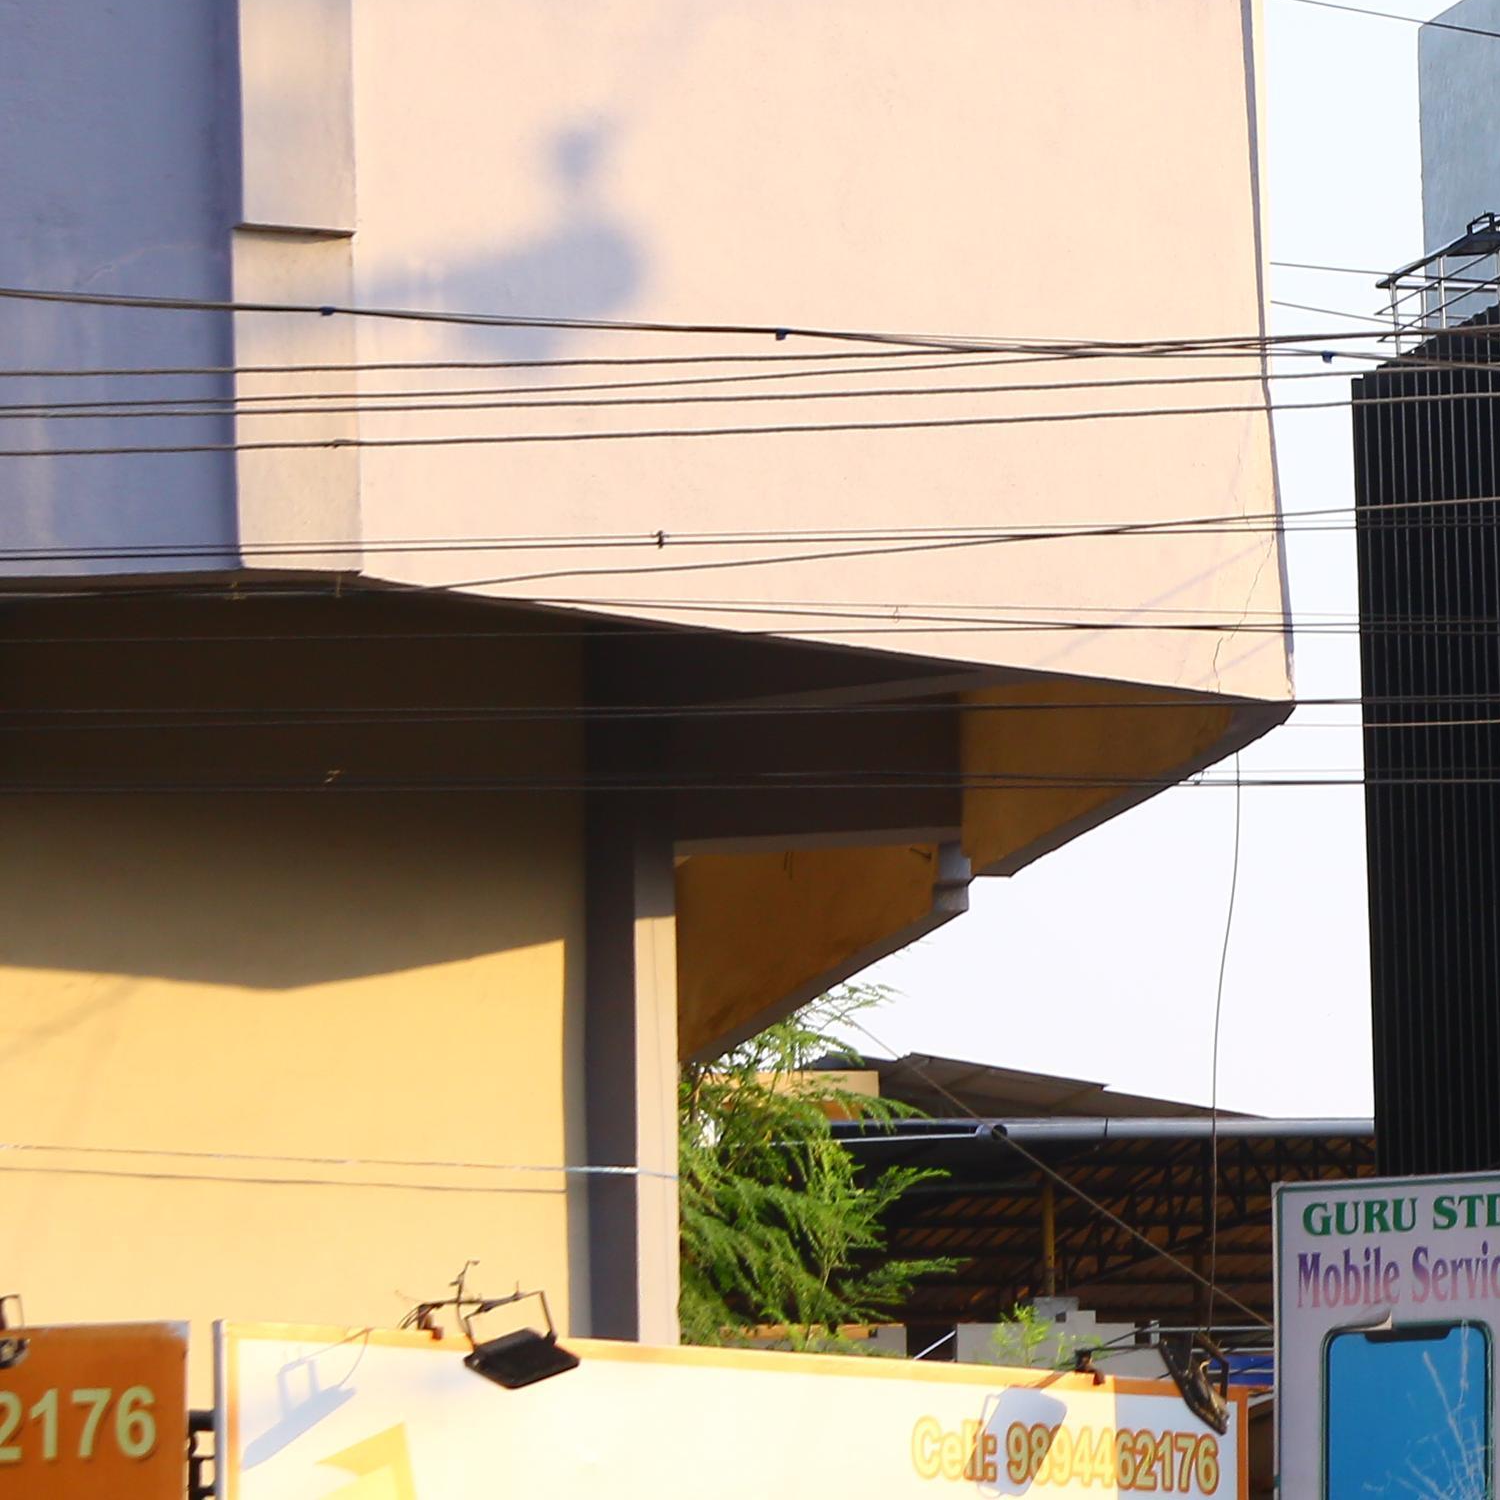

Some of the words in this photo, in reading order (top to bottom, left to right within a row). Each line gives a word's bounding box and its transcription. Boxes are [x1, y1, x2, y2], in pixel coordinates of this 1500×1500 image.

[1302, 1198, 1418, 1236] GURU
[1297, 1246, 1400, 1308] Mobile
[0, 1385, 157, 1461] 2176
[911, 1415, 997, 1483] Cell:
[1006, 1421, 1220, 1496] 9894462176
